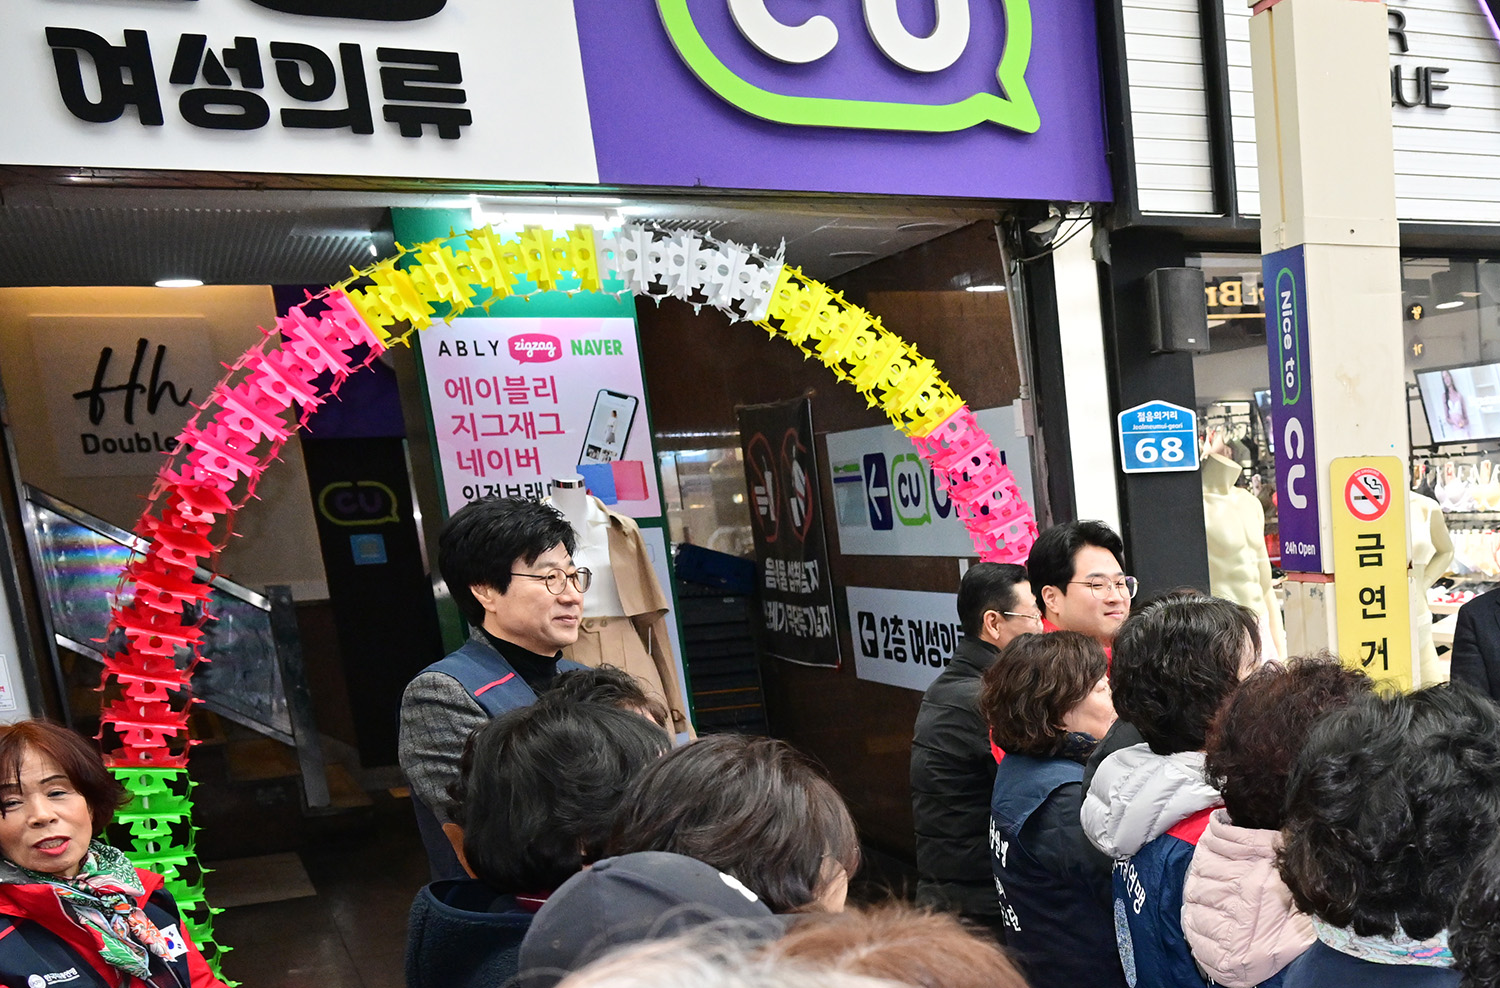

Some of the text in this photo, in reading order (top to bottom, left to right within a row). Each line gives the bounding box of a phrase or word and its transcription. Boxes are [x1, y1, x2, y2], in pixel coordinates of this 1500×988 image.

[45, 26, 473, 139] 여성의류
[1390, 65, 1452, 111] UE
[438, 339, 624, 358] ABLY zigzag NAVER
[1281, 290, 1296, 389] Nice to
[444, 375, 559, 406] 에이블리
[451, 411, 566, 442] 지그재그
[1137, 410, 1178, 423] 젊음의거리
[456, 447, 542, 477] 네이버
[1135, 437, 1184, 463] 68
[1284, 417, 1307, 509] CU
[898, 472, 921, 508] CU
[1285, 542, 1316, 557] 24h Open
[880, 614, 965, 669] 2층 여성의
